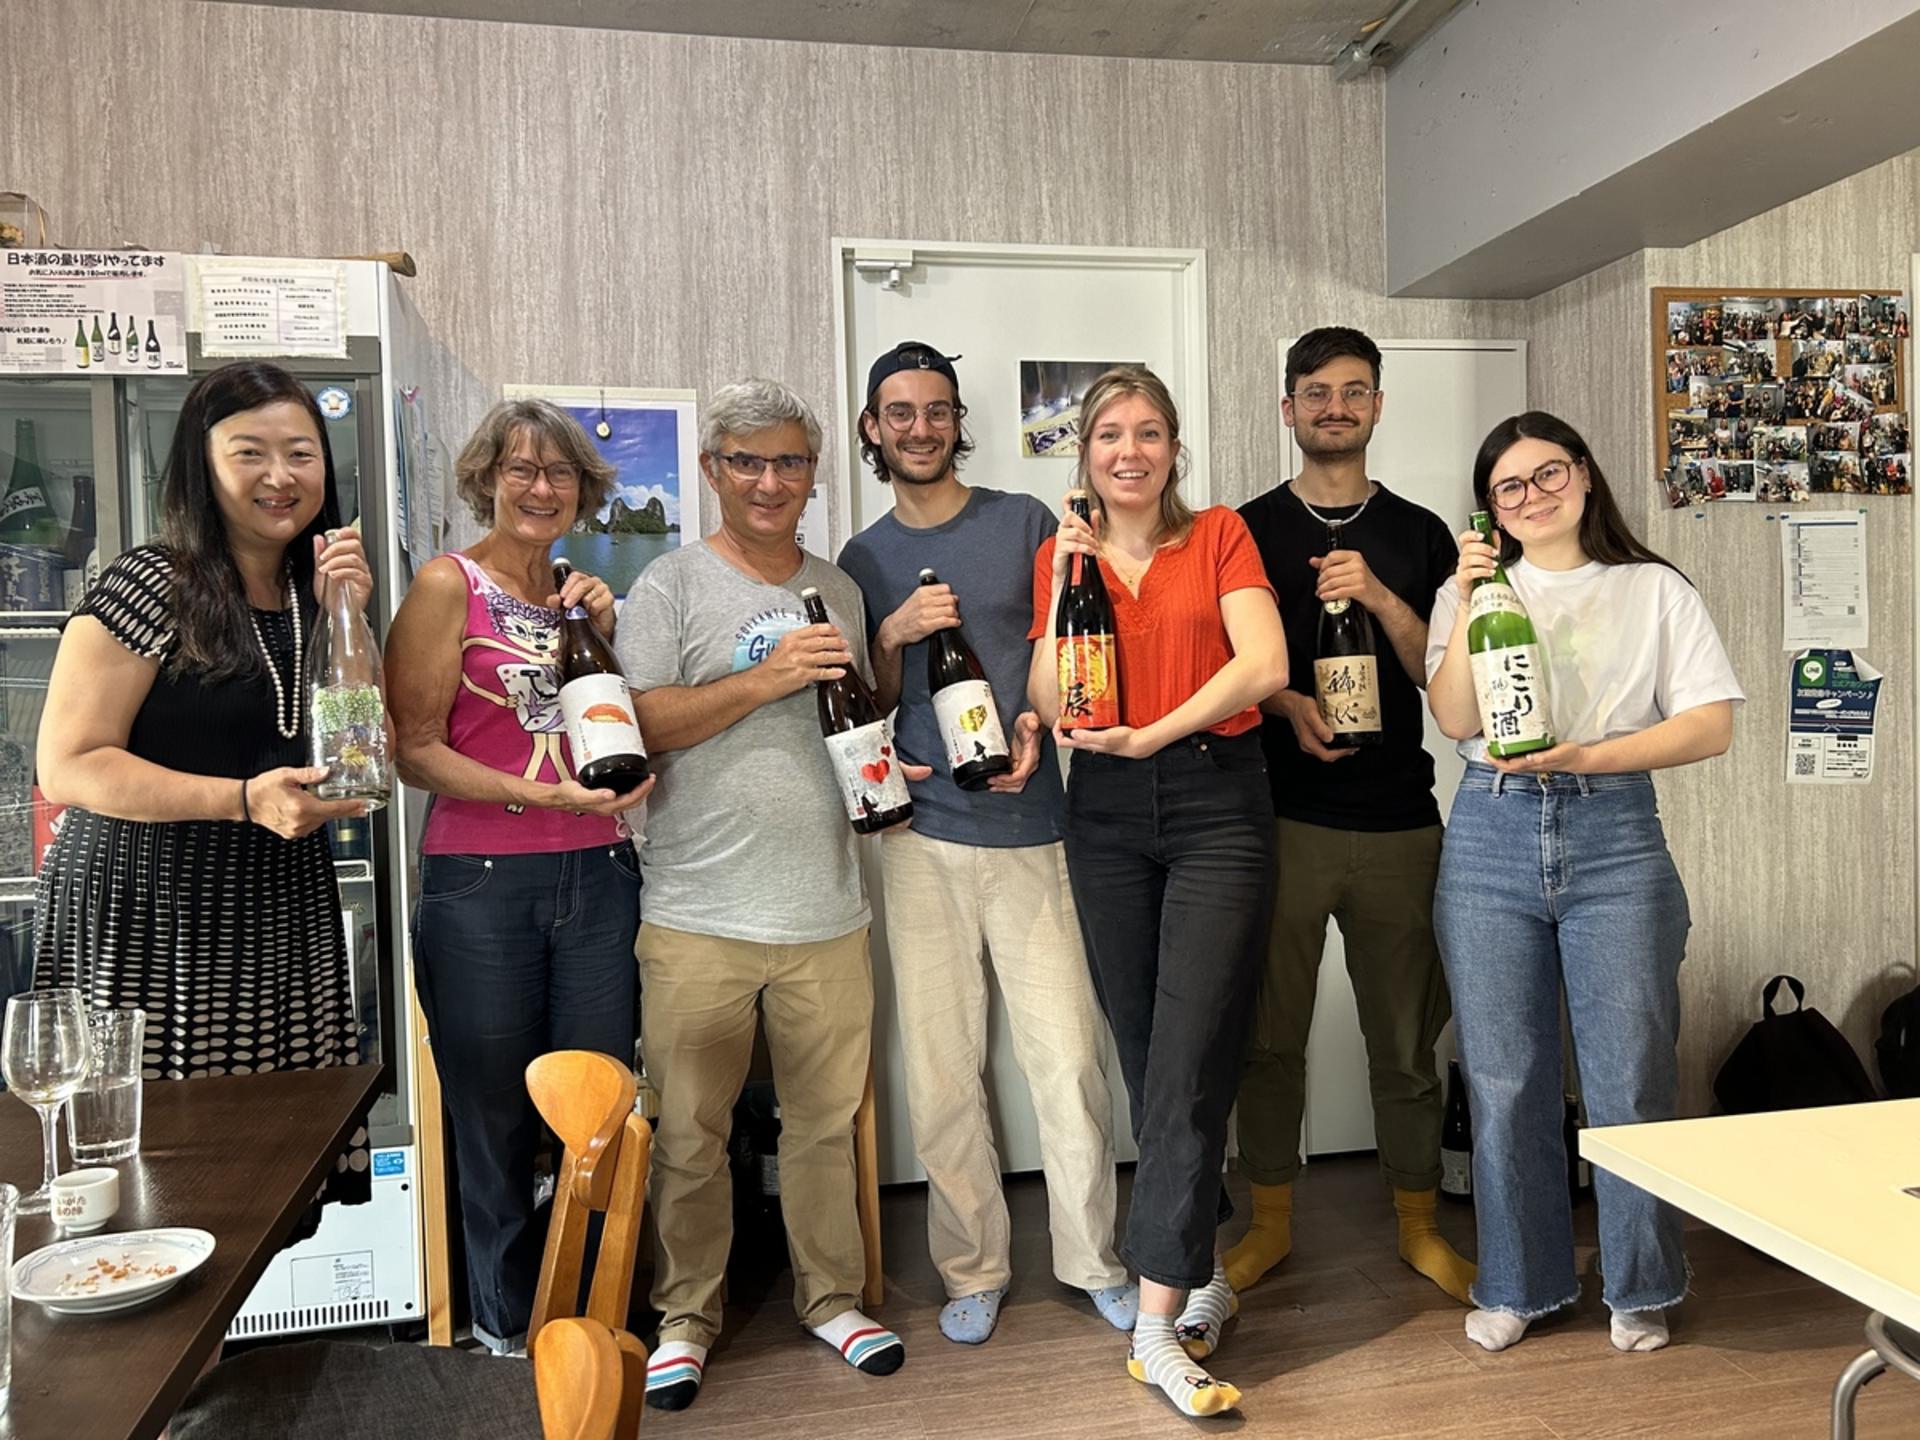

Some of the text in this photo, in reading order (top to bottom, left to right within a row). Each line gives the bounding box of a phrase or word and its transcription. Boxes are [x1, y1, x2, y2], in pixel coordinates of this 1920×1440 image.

[7, 252, 166, 268] 日本酒の量り売りやってます
[735, 607, 788, 642] SOIXANTE
